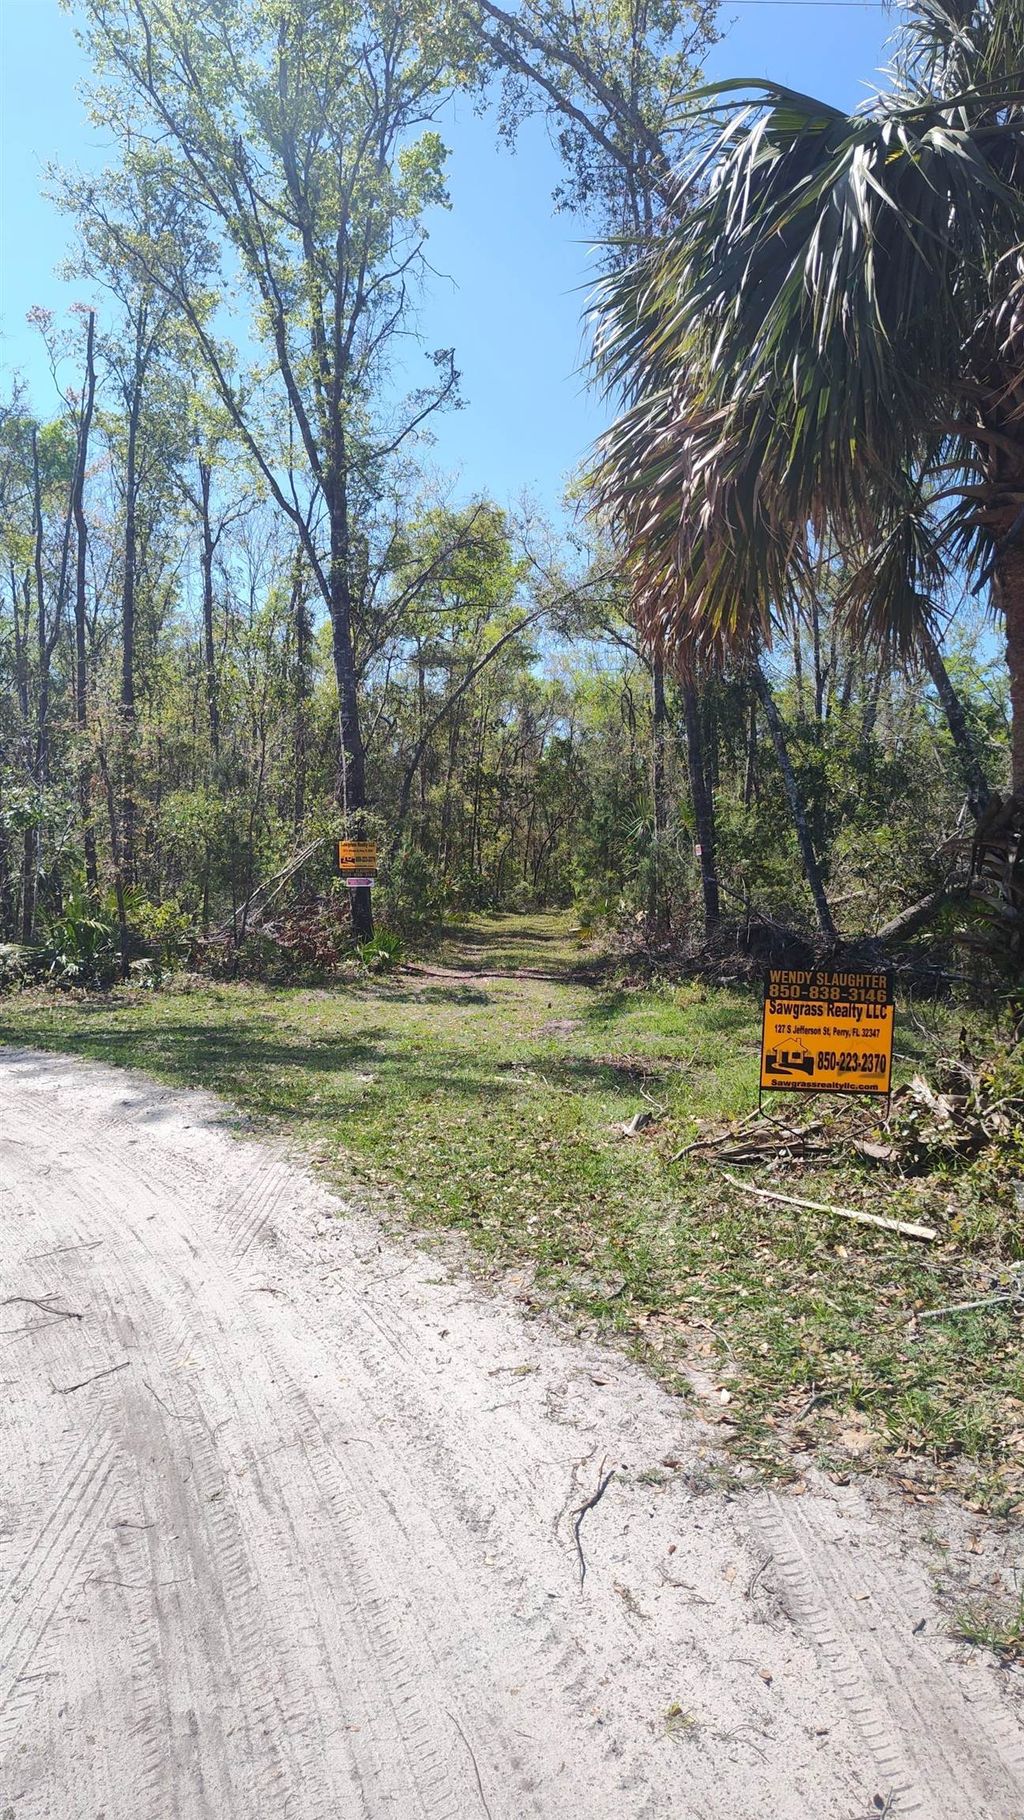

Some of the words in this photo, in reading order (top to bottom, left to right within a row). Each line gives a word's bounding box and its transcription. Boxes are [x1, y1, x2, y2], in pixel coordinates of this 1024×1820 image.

[770, 970, 812, 985] WENDY
[816, 972, 887, 989] SLAUGHTER
[769, 984, 887, 1003] 850-838-3146
[769, 1000, 823, 1020] Sawgrass
[827, 1002, 863, 1022] Realty
[866, 1004, 887, 1020] LLC
[775, 1024, 786, 1034] 127
[786, 1024, 792, 1034] S
[793, 1025, 821, 1035] Jefferson
[852, 1028, 860, 1037] FL
[861, 1028, 880, 1038] 32347
[817, 1051, 887, 1073] 850-223-2370
[771, 1079, 879, 1090] Sawgrassrealtyllc.com
